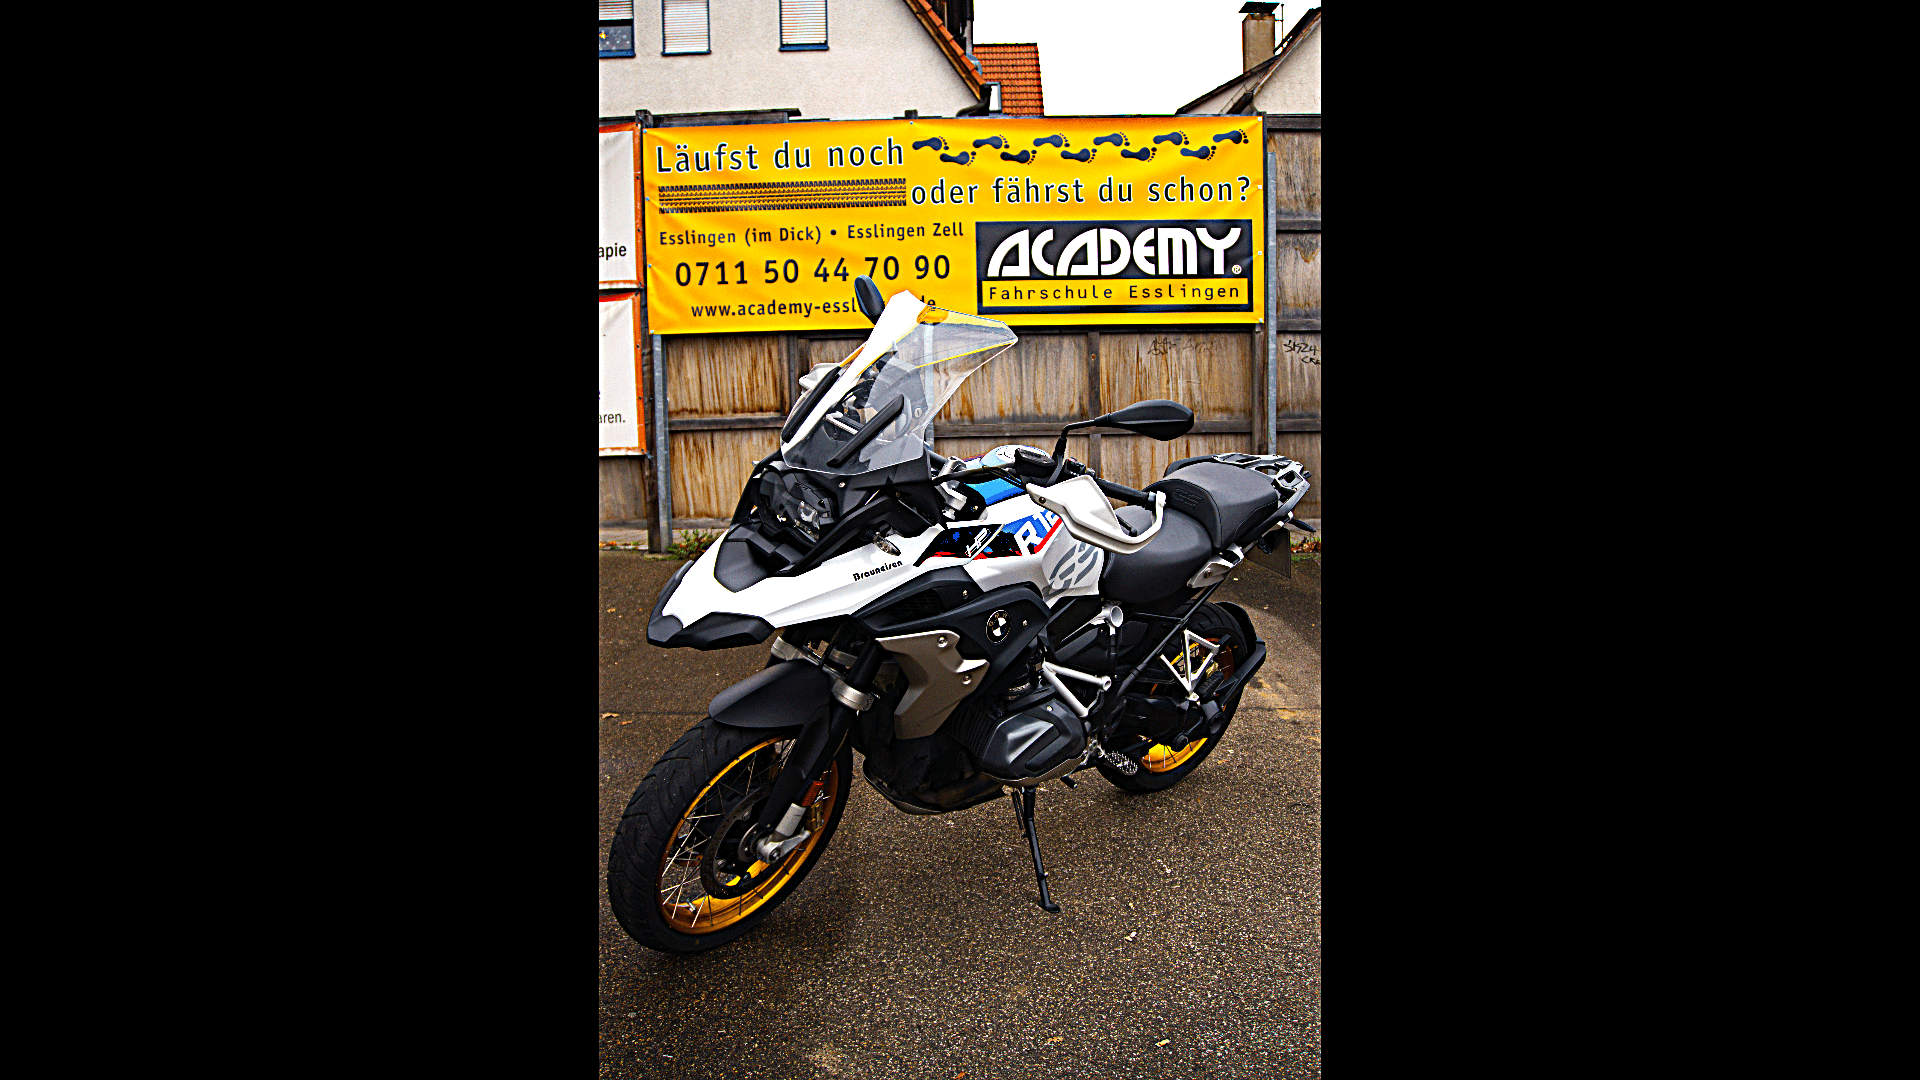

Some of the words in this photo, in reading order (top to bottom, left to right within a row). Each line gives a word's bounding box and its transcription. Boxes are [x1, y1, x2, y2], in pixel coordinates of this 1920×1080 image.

[656, 142, 758, 173] Läufst
[773, 140, 811, 170] du
[827, 136, 904, 168] noch
[911, 177, 978, 205] oder
[991, 176, 1084, 204] fährst
[1098, 175, 1133, 203] du
[1147, 175, 1251, 202] schon?
[659, 230, 736, 248] Esslingen
[744, 227, 772, 247] (im
[779, 225, 822, 242] Dick)
[847, 223, 925, 241] Esslingen
[932, 221, 964, 237] Zell
[675, 260, 749, 287] 0711
[764, 258, 799, 284] 50
[813, 257, 850, 283] 44
[864, 255, 900, 280] 70
[914, 254, 950, 280] 90
[988, 285, 1113, 300] Fahrschule
[1129, 284, 1240, 301] Esslingen
